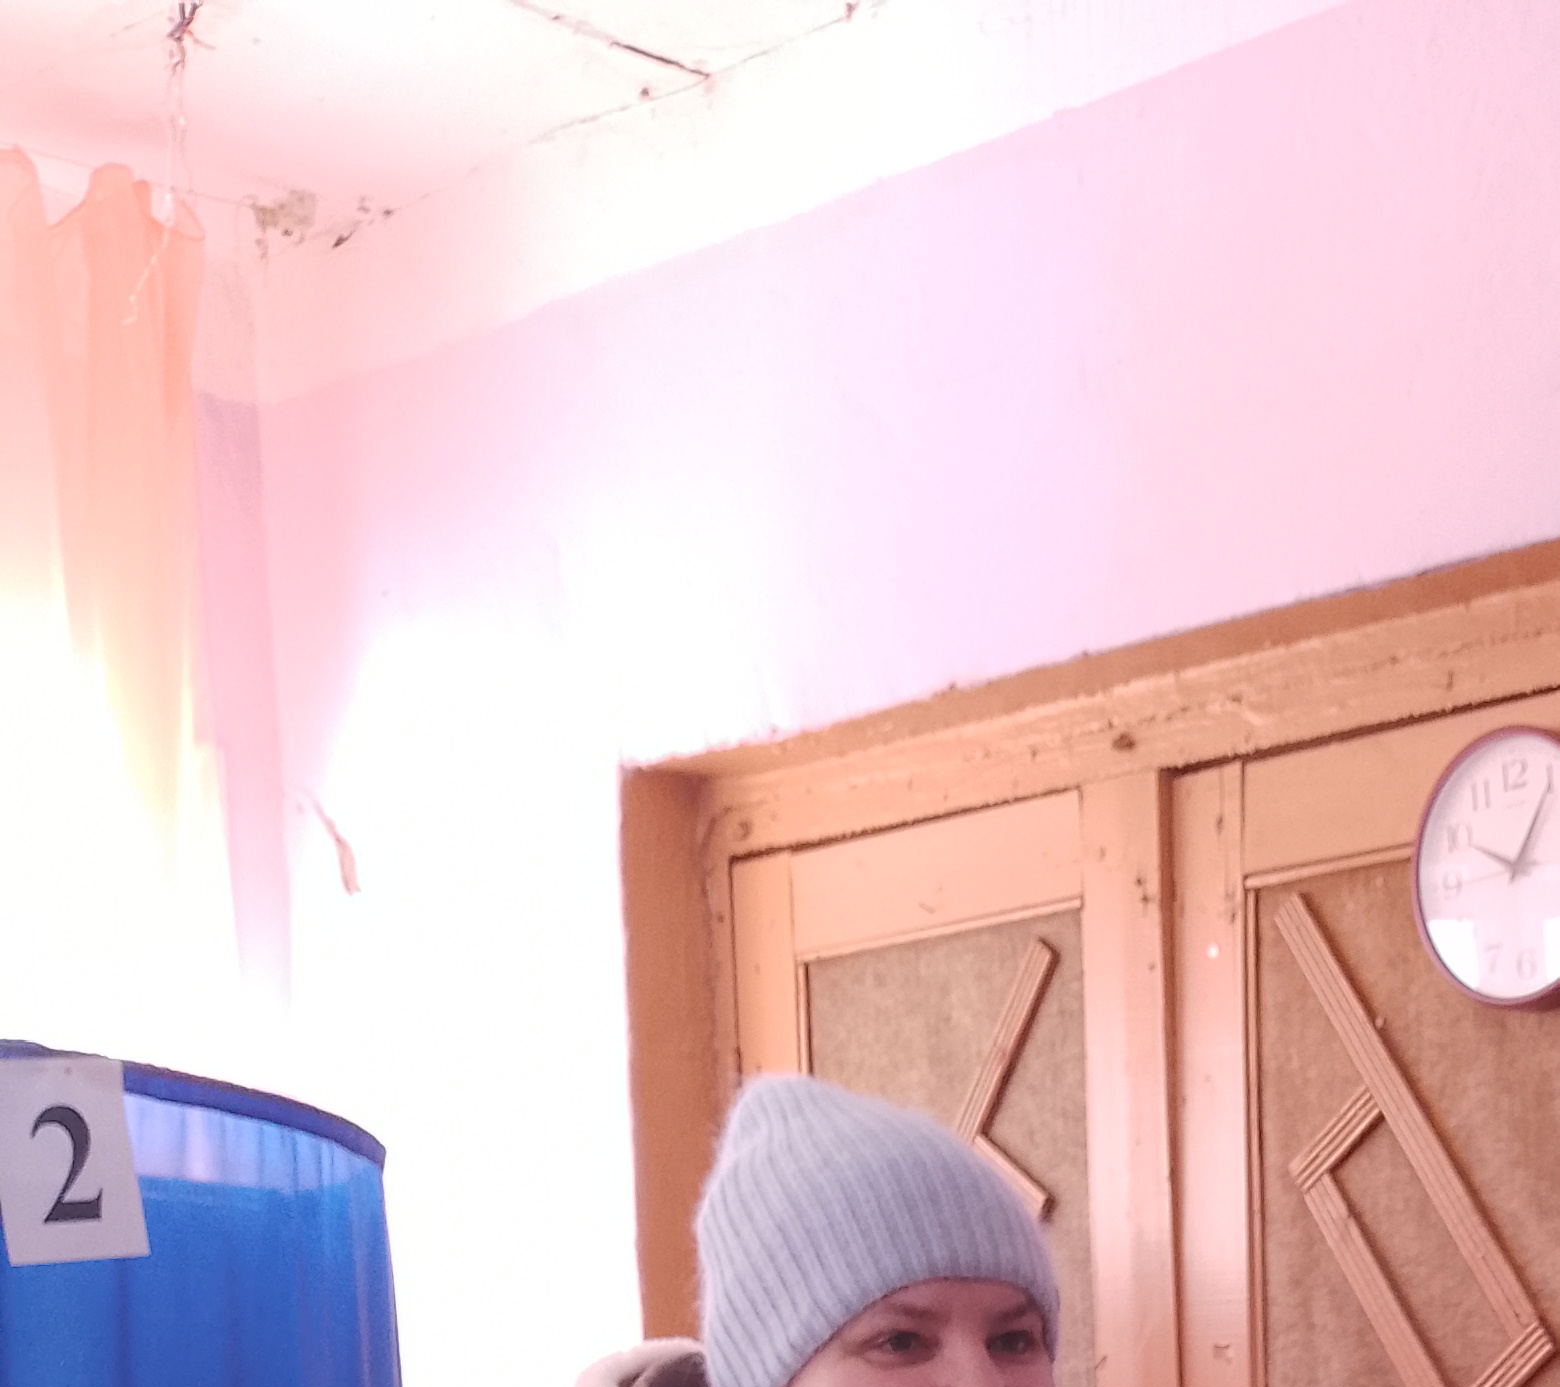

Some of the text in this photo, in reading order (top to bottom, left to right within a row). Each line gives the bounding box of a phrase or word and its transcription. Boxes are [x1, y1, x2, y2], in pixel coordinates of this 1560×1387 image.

[1501, 758, 1529, 793] 12
[1470, 778, 1491, 812] 11
[1446, 819, 1474, 854] 10
[1442, 869, 1463, 898] 9
[1483, 940, 1504, 974] 7
[1515, 947, 1538, 980] 6
[30, 1105, 104, 1224] 2
